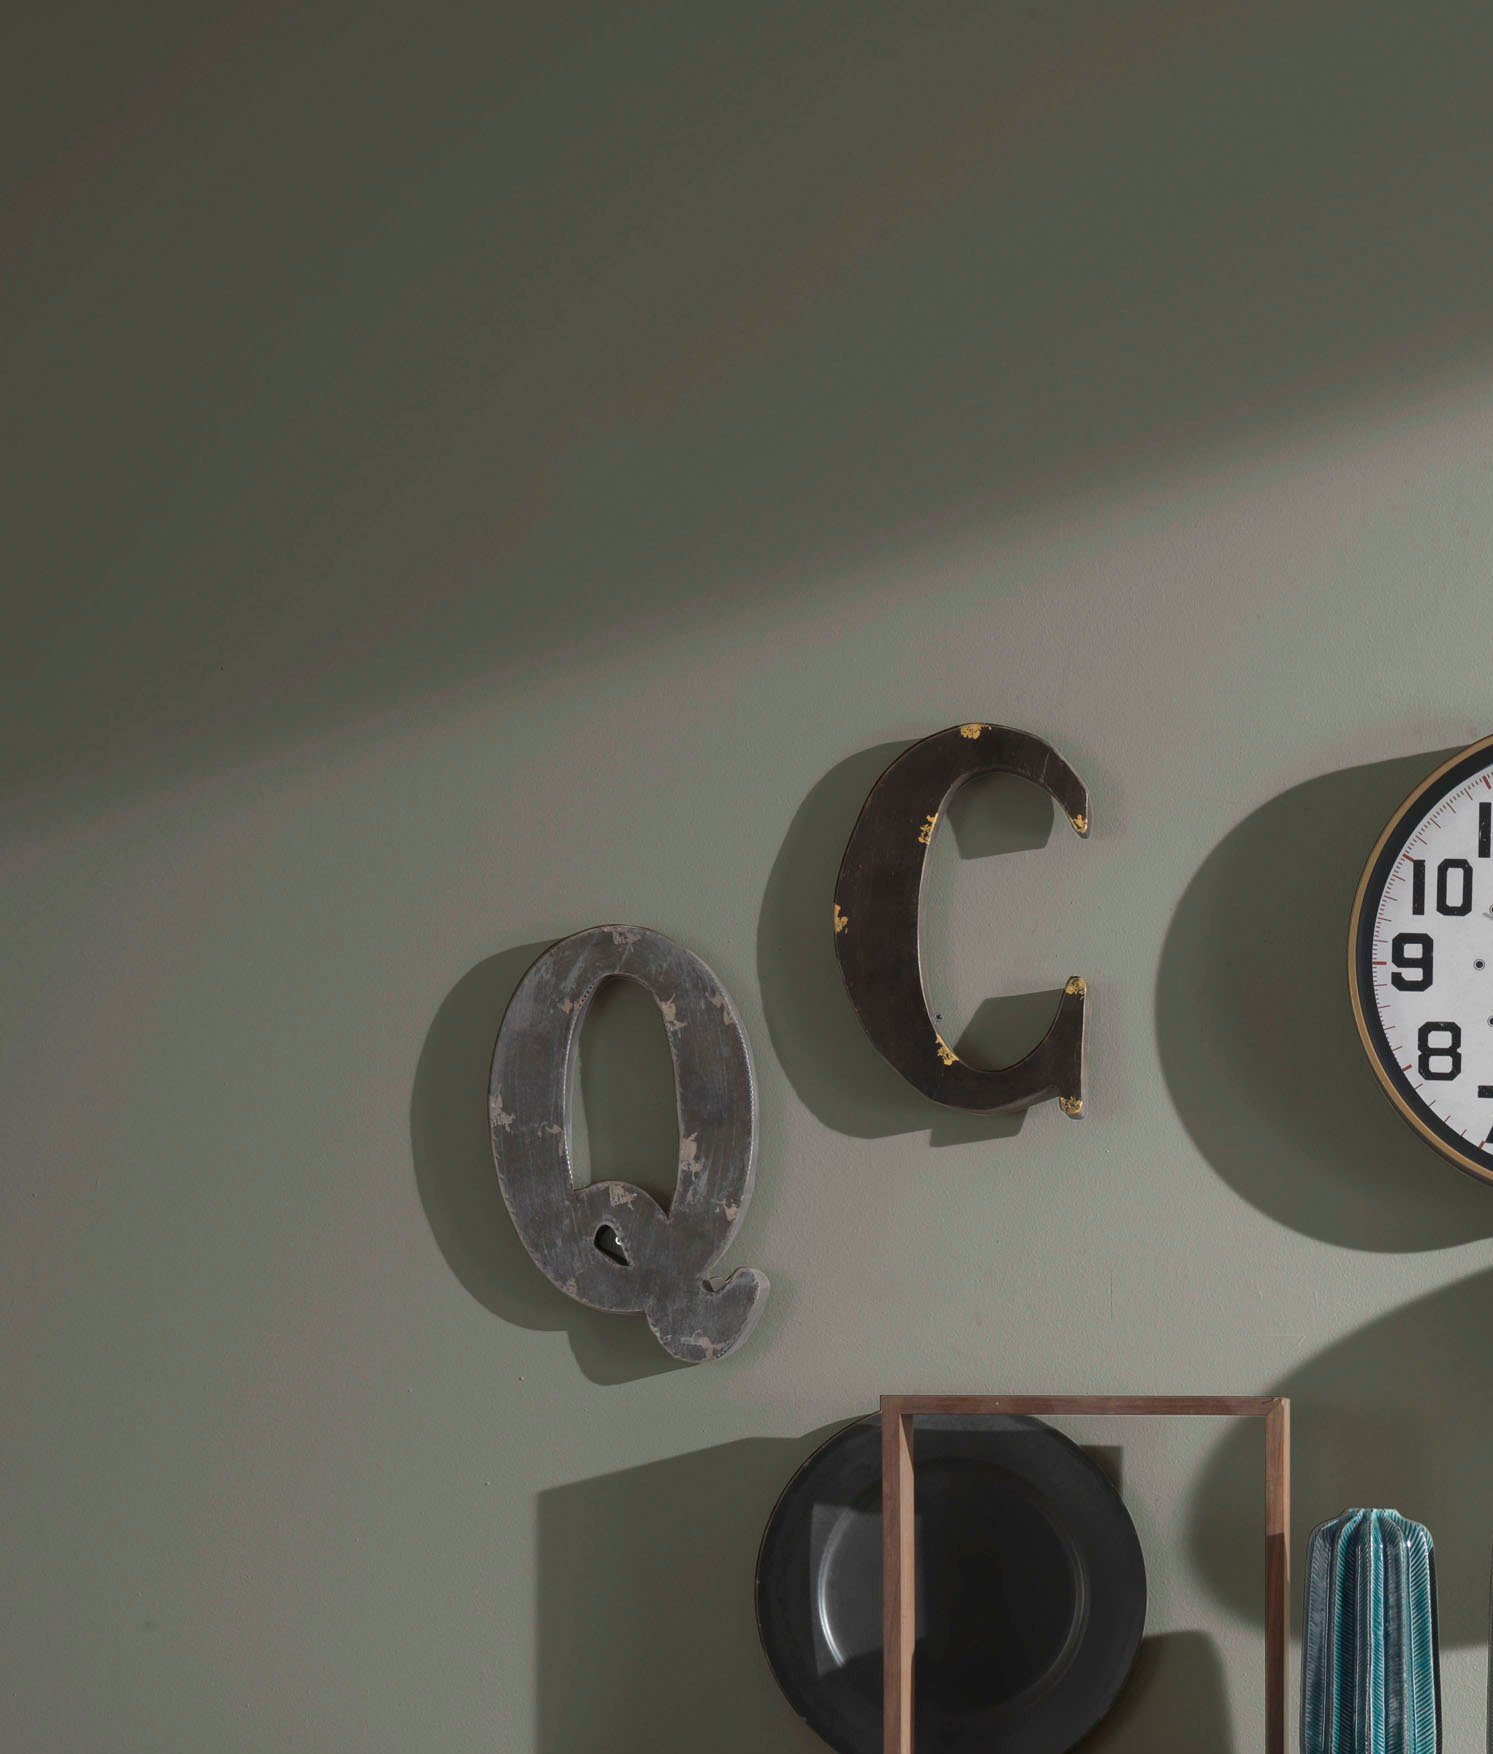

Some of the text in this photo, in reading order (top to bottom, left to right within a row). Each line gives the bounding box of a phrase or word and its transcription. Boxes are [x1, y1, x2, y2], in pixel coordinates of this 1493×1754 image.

[1412, 858, 1473, 916] 10
[1391, 932, 1434, 992] 9
[1417, 1021, 1462, 1081] 8
[488, 923, 770, 1363] Q
